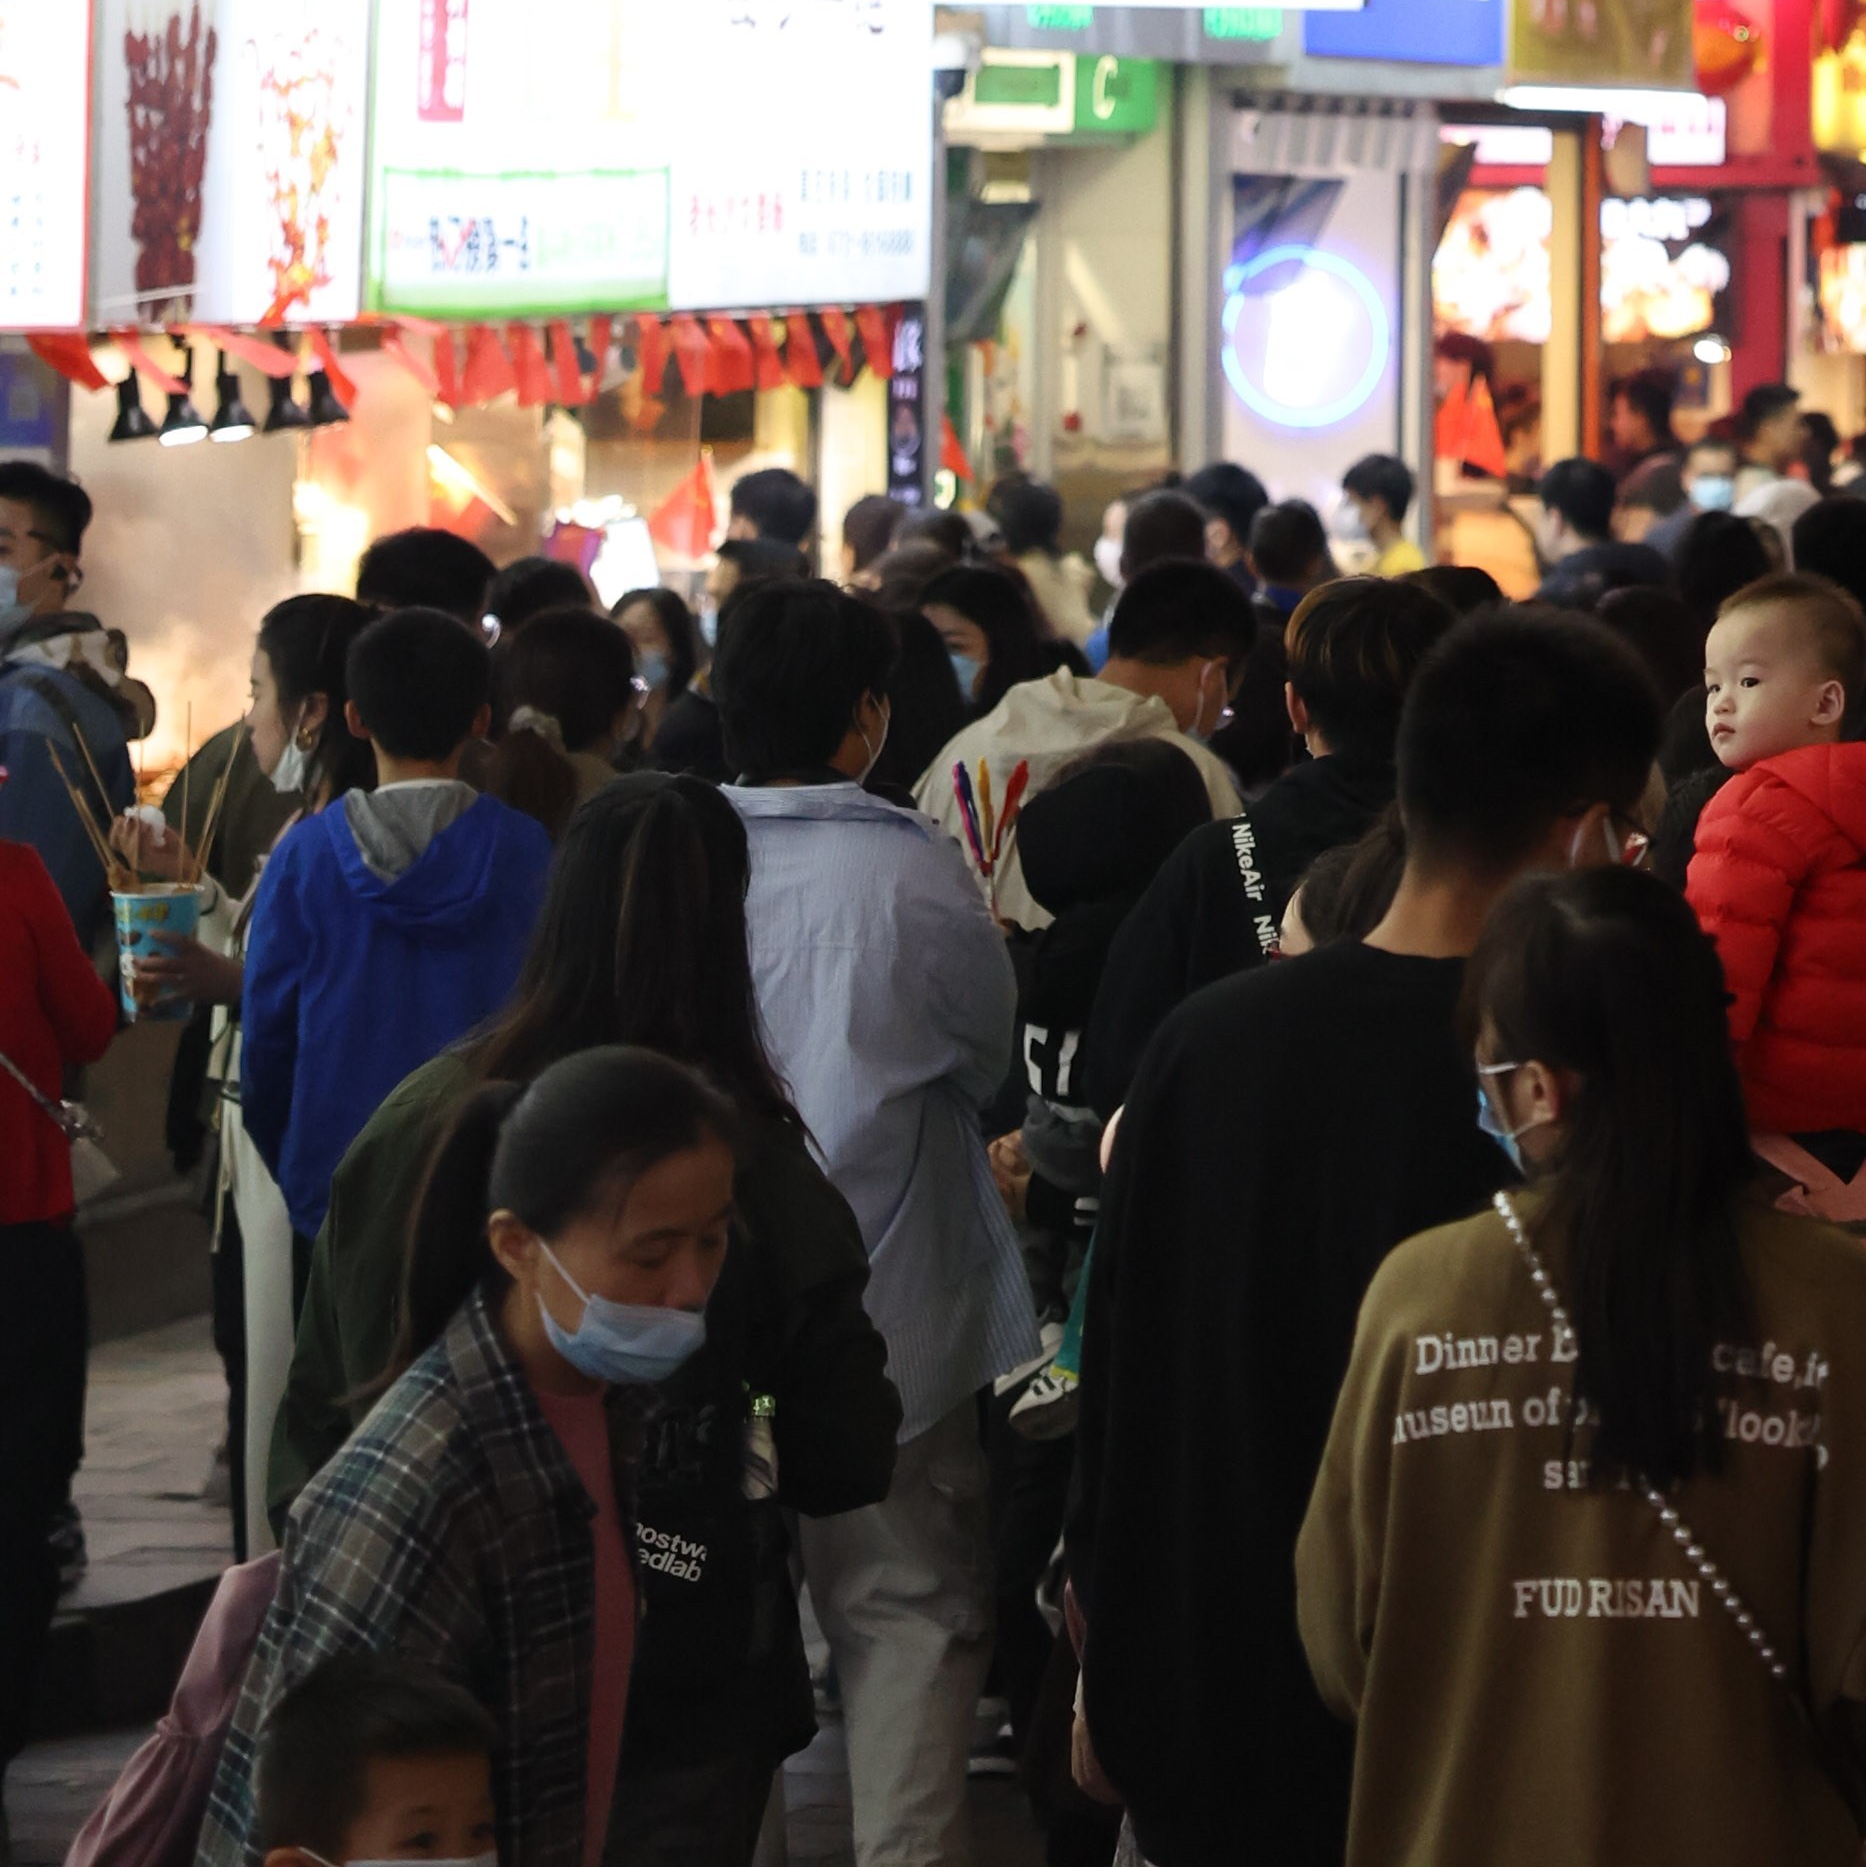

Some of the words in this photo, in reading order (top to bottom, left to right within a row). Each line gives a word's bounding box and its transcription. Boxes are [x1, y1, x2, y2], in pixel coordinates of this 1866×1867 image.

[1231, 823, 1267, 903] NikeAir
[1415, 1331, 1542, 1376] Dinner
[1522, 1385, 1563, 1428] of
